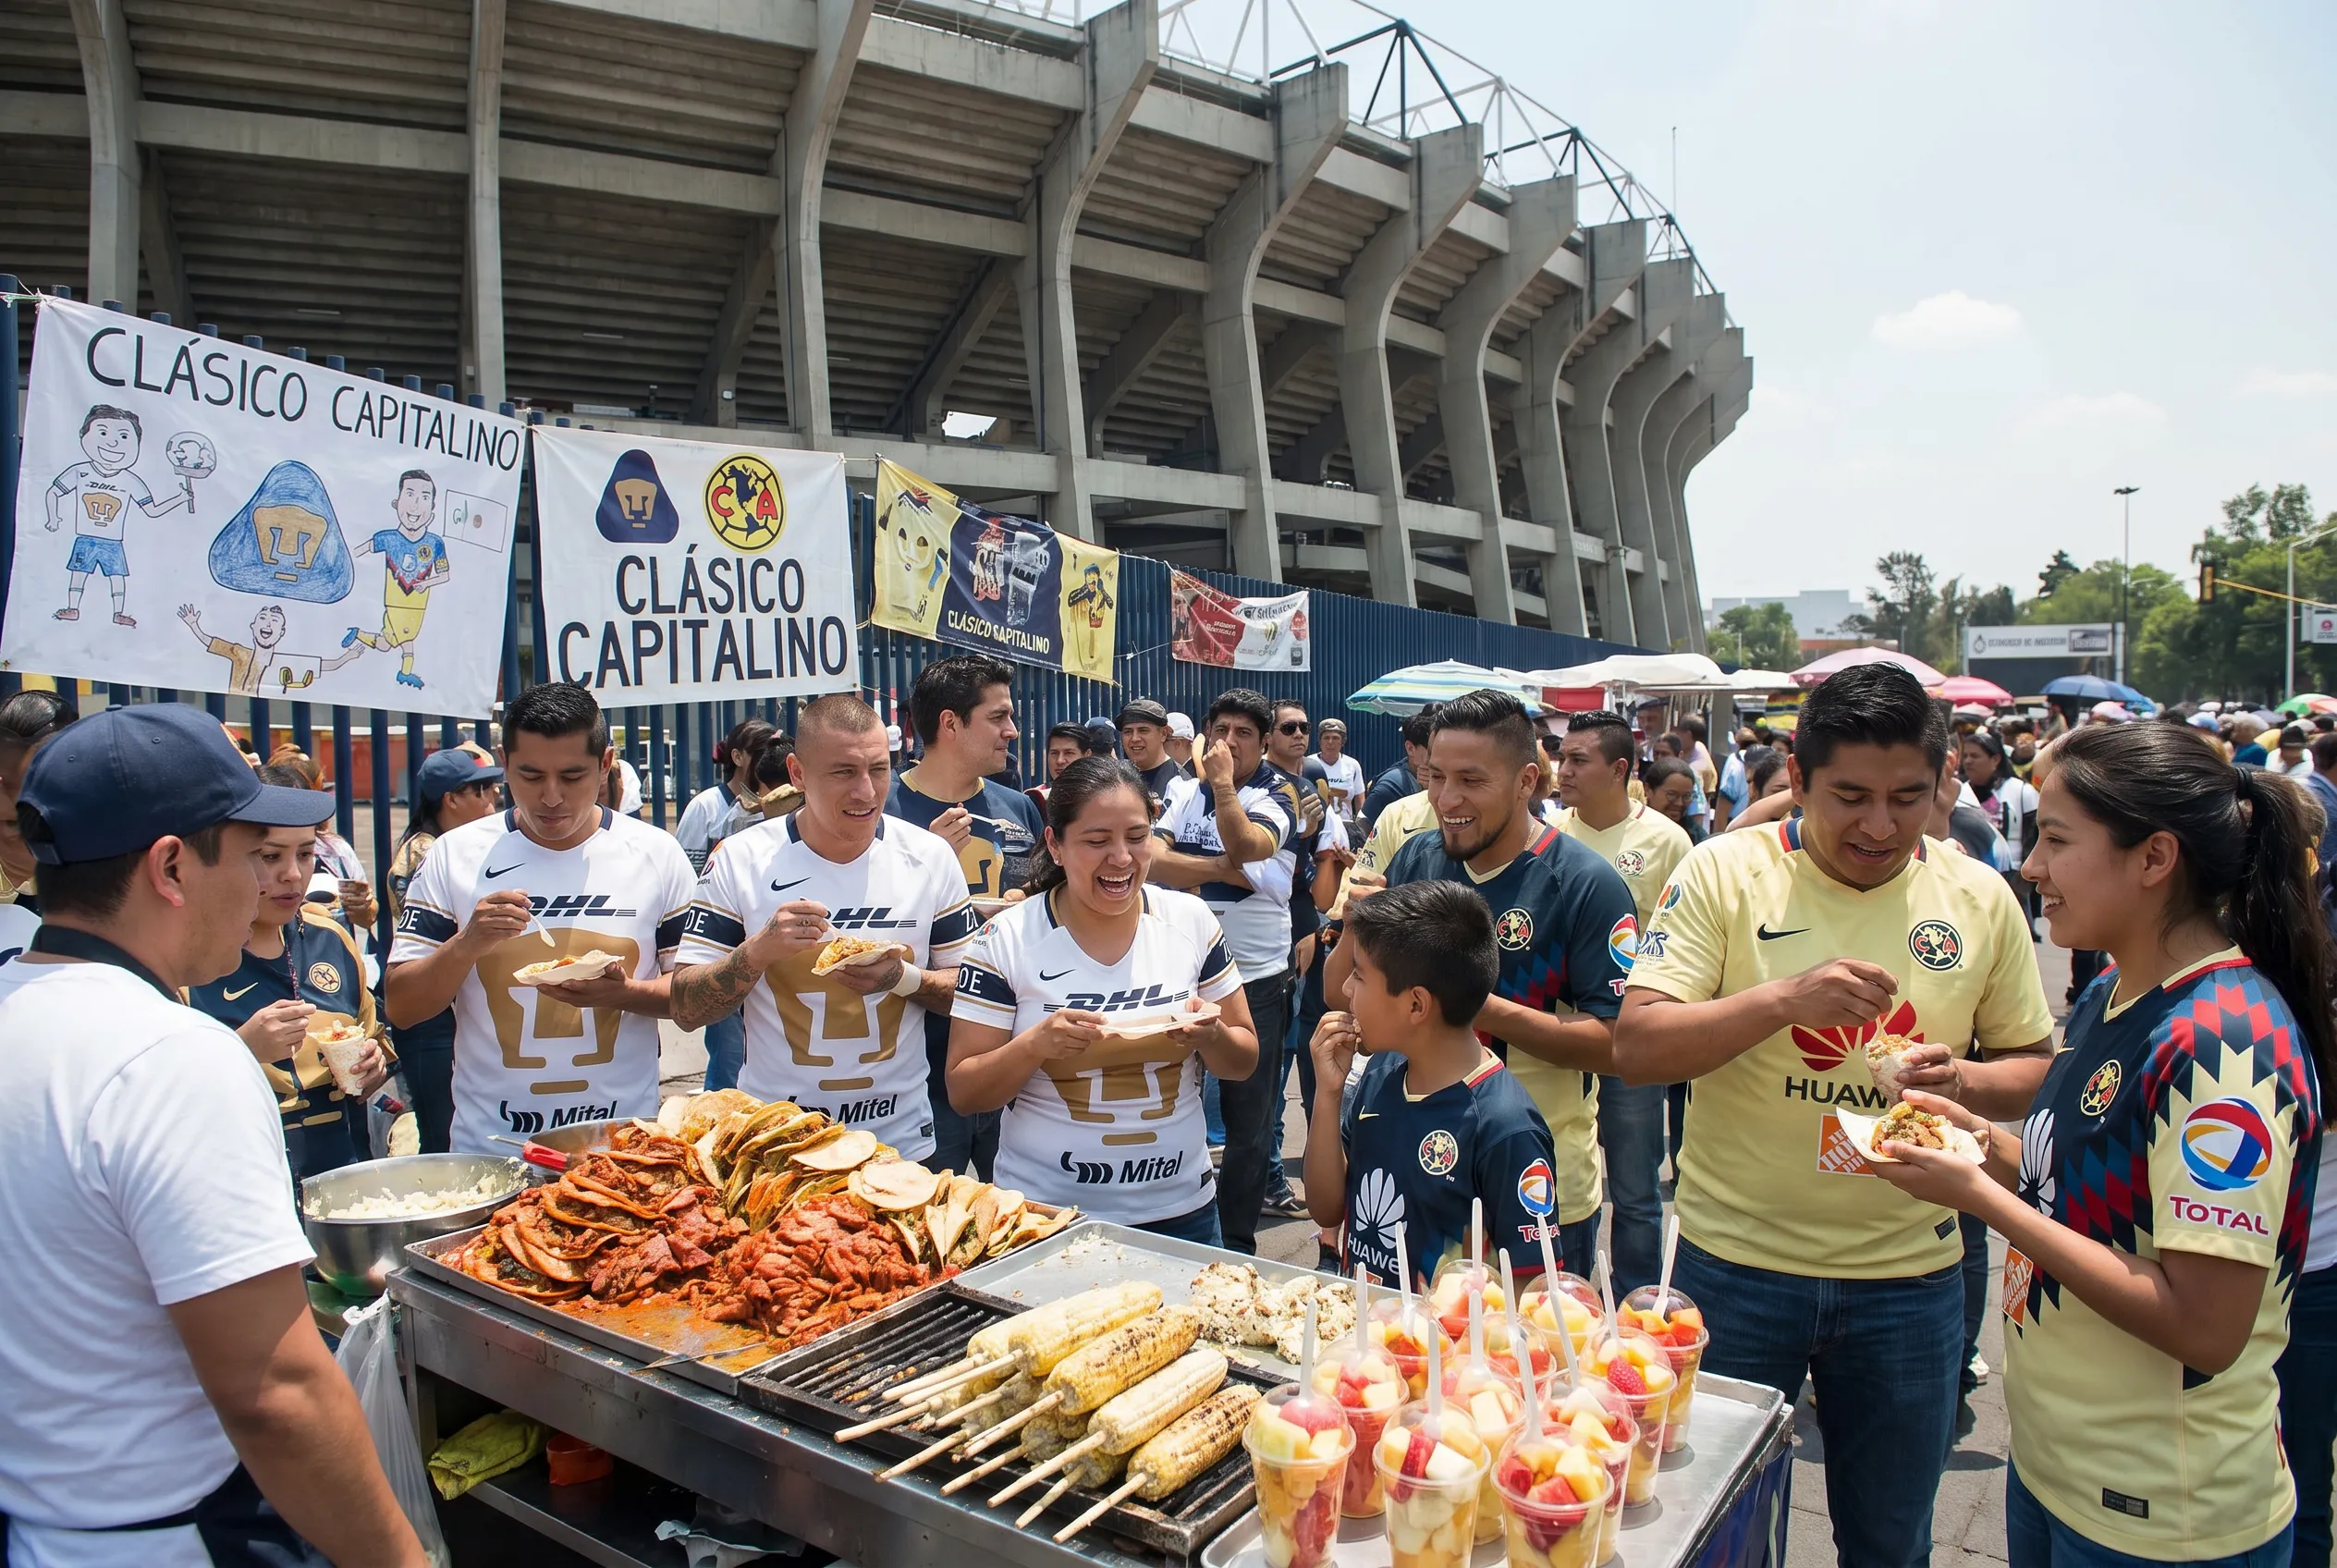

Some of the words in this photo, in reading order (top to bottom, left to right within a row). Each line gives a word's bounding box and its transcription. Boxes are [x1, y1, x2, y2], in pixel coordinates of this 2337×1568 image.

[87, 326, 308, 422] CLÁSICO
[332, 386, 520, 472] CAPITALINO
[616, 544, 805, 616] CLÁSICO
[557, 616, 848, 690] CAPITALINO
[826, 907, 899, 929] HL
[1066, 984, 1174, 1012] DHL
[838, 1094, 898, 1124] Mitel
[1785, 1076, 1888, 1109] HUAW
[1119, 1150, 1183, 1183] Mitel
